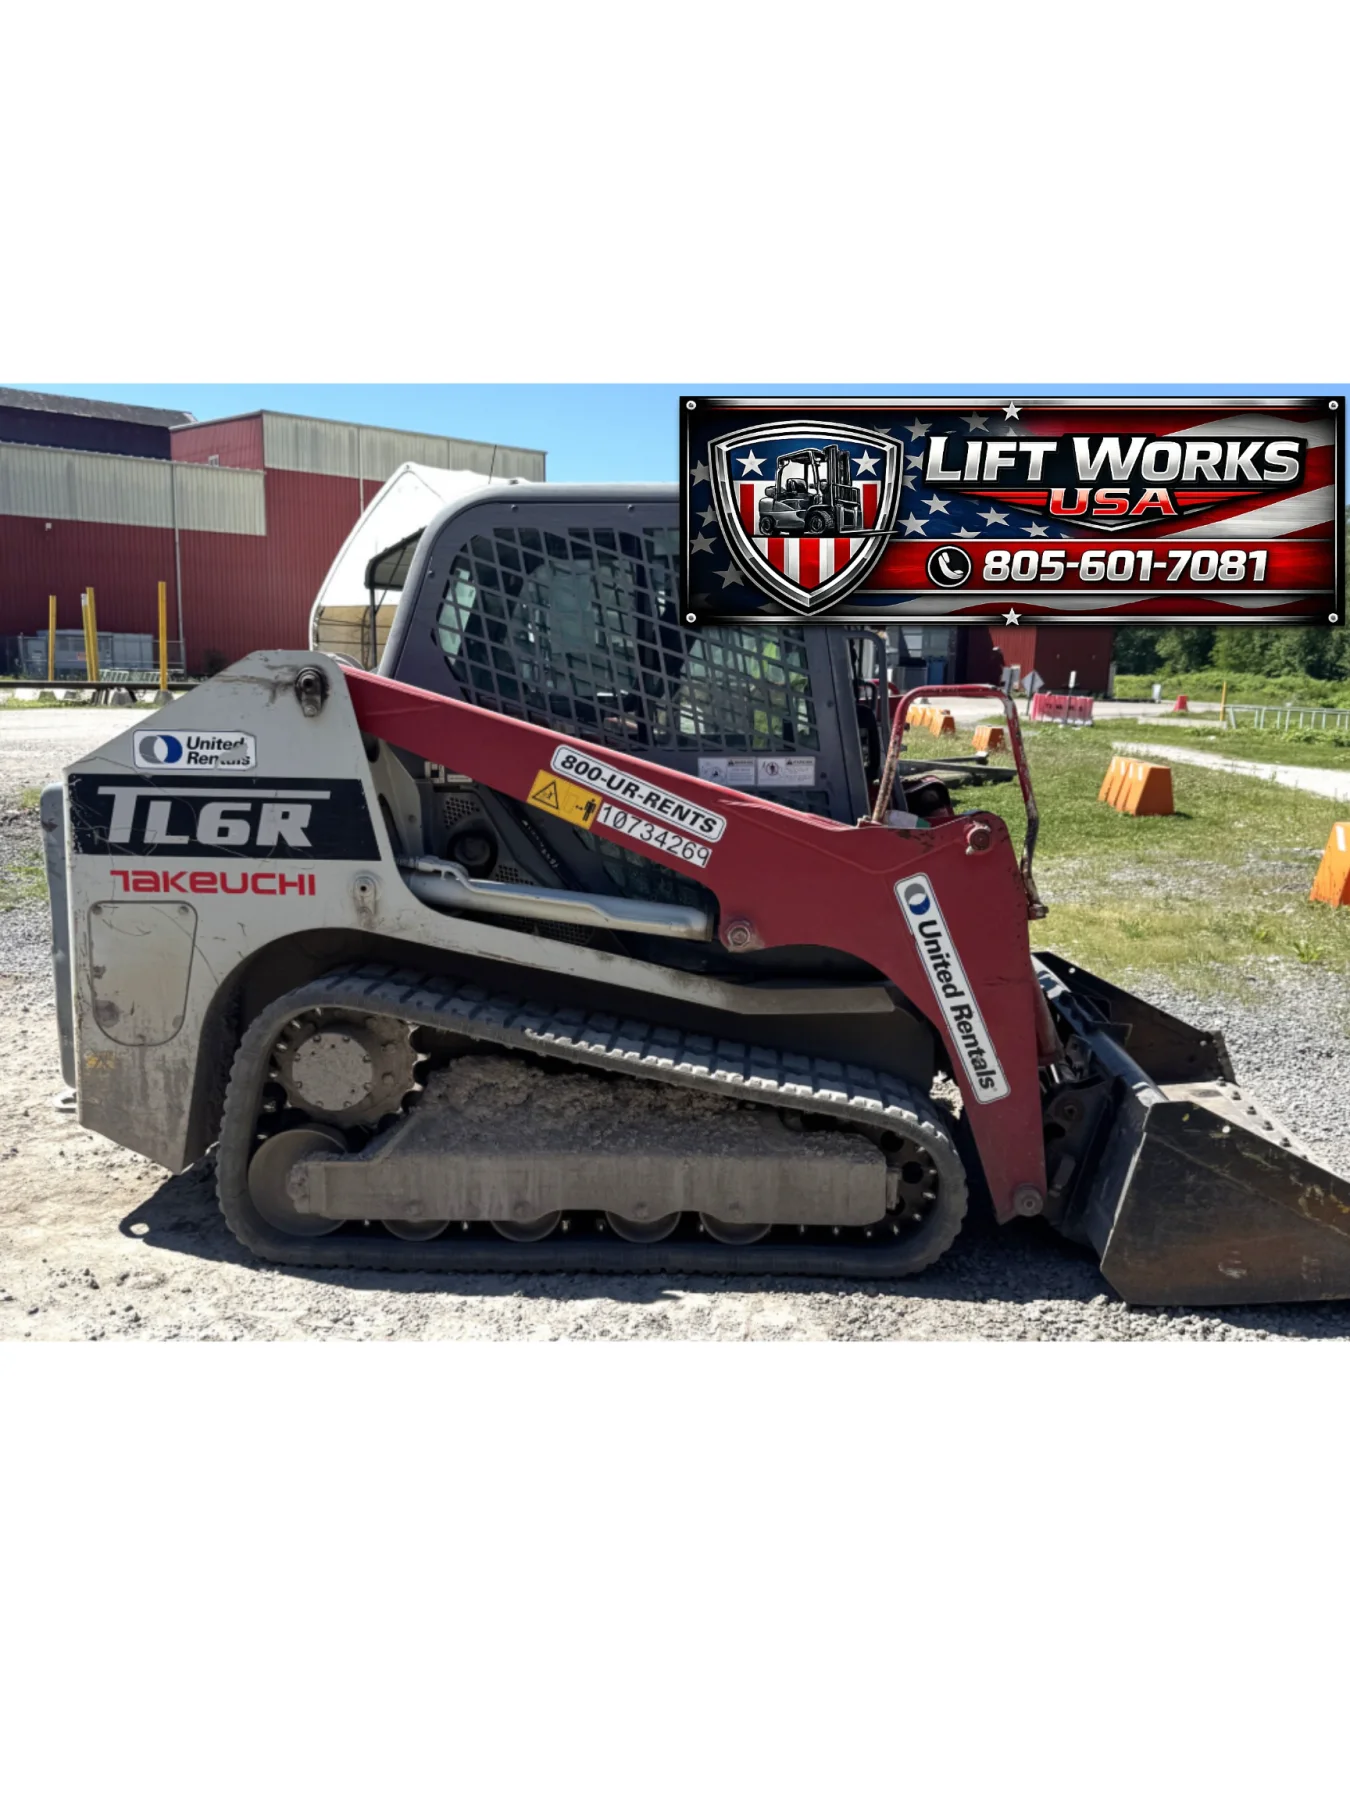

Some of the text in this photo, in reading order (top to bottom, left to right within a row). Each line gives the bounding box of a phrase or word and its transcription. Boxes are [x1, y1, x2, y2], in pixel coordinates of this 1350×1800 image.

[97, 786, 331, 847] TL6R
[561, 755, 717, 833] 800-UR-RENTS
[602, 805, 711, 866] 10734269
[917, 919, 996, 1090] United Rentals
